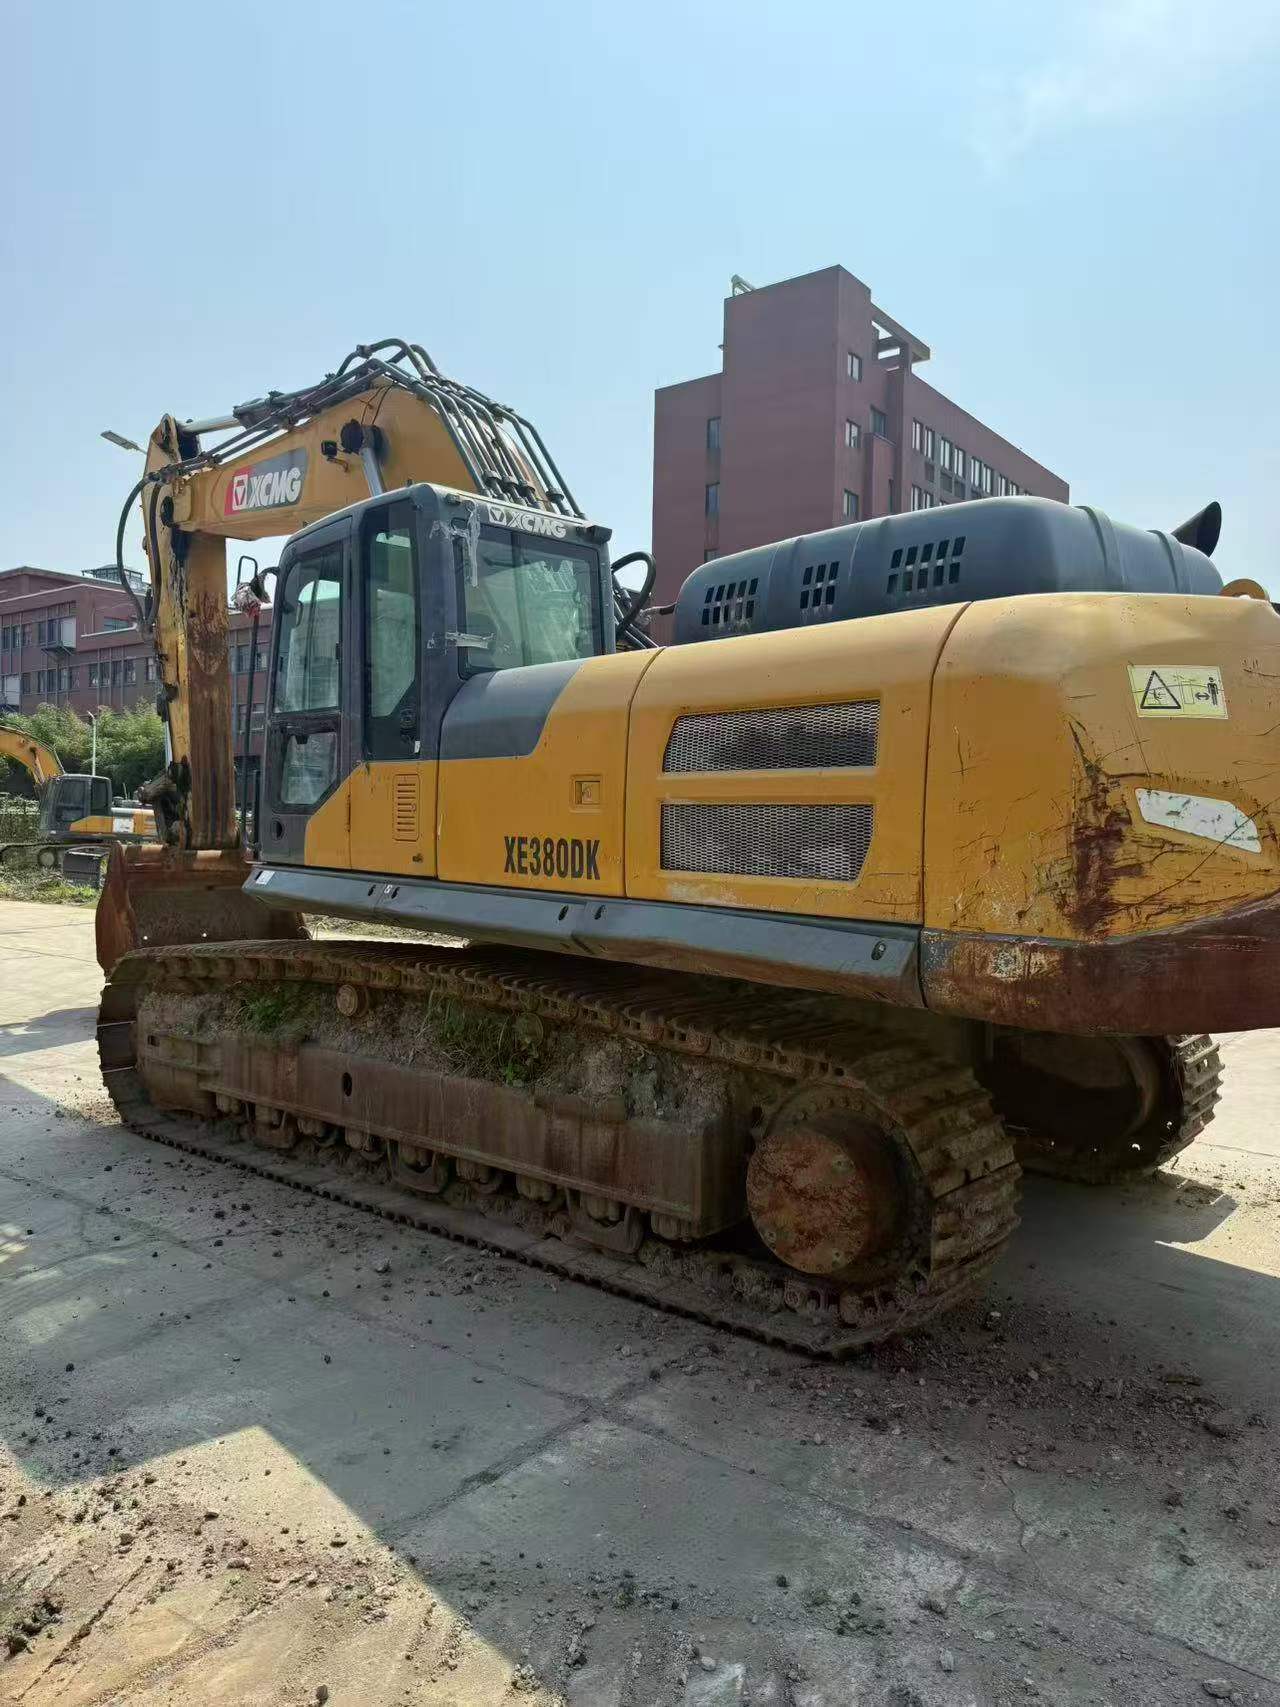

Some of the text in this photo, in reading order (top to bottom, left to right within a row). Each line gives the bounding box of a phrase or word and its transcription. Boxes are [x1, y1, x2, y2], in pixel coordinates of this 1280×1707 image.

[248, 467, 302, 508] XCMG
[507, 511, 567, 539] XCMG
[503, 835, 601, 881] XE380DK
